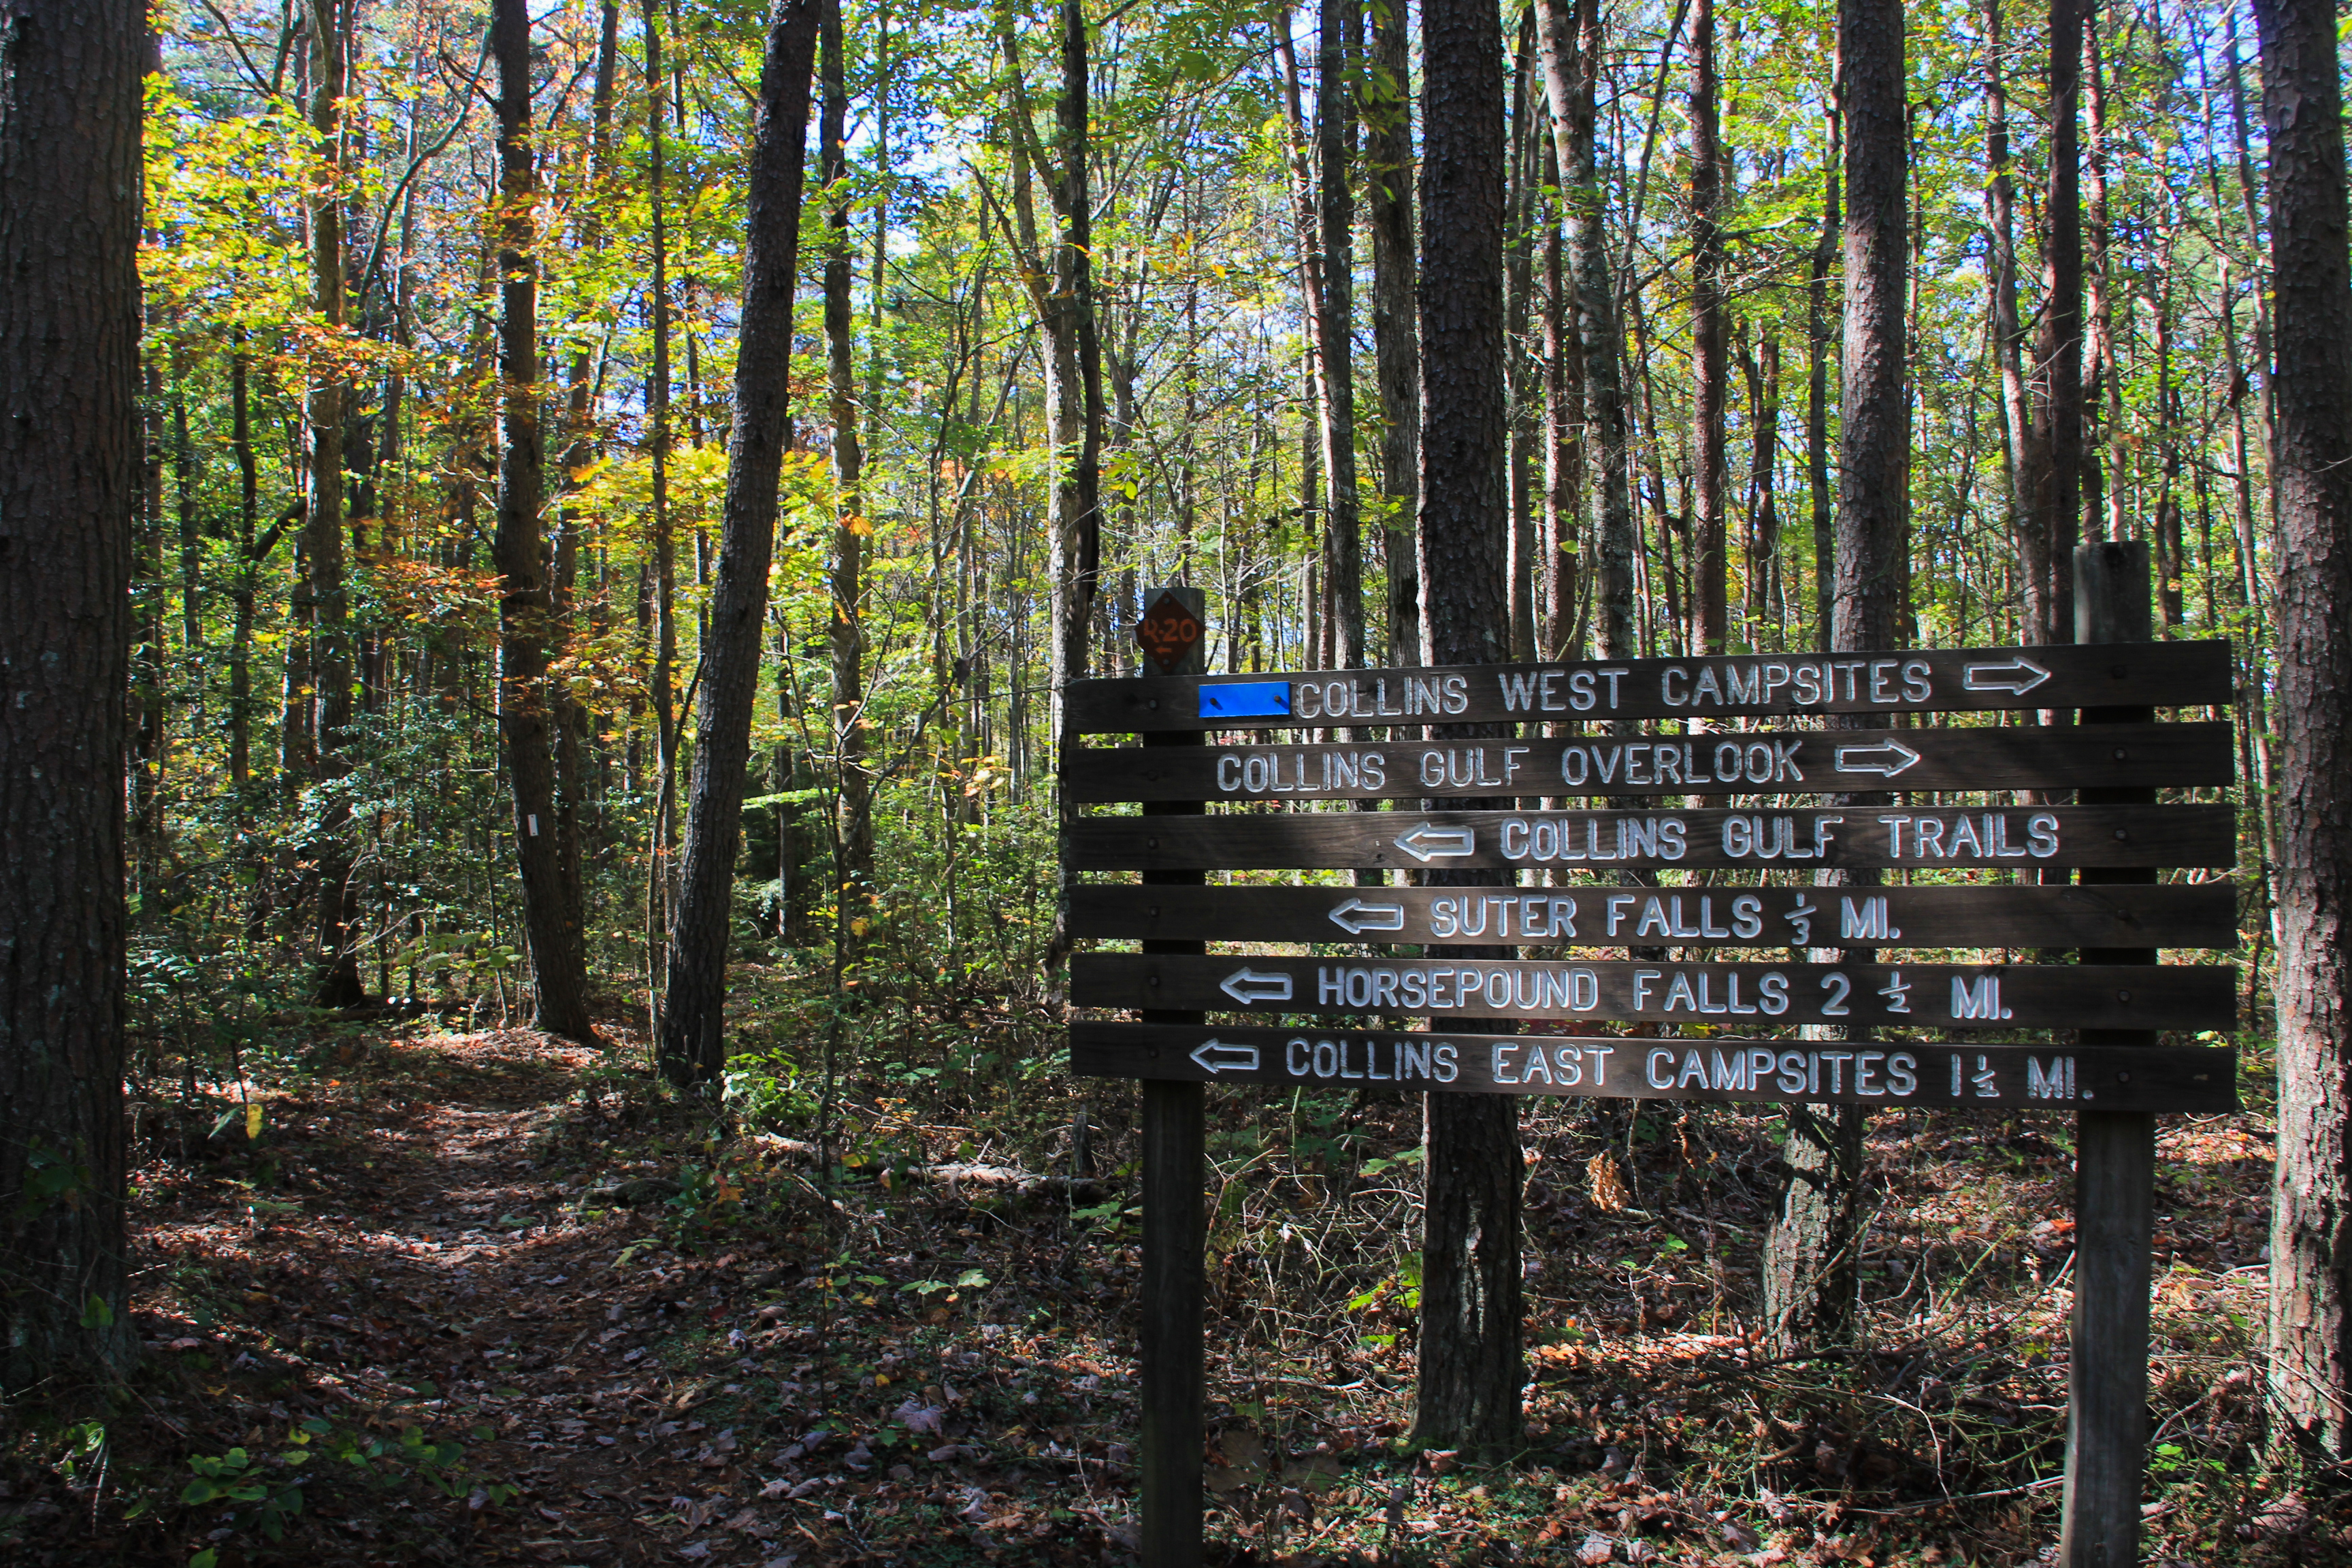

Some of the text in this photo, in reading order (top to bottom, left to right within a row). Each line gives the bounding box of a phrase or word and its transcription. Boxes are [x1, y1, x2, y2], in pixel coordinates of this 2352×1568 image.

[1294, 659, 1931, 719] COLLINS WEST CAMPSITES
[1218, 739, 1803, 793] COLLINS GULF OVERLOOK
[1500, 812, 2059, 862] COLLINS GULF TRAILS
[1429, 894, 1578, 938] SUTER
[1607, 894, 1763, 940] FALLS
[1840, 896, 1901, 940] MI.
[1318, 966, 1599, 1011] HORSEPOUND
[1633, 970, 1790, 1015] FALLS
[1820, 973, 1851, 1015] 2
[1951, 975, 2012, 1020] MI.
[1286, 1038, 1459, 1082] COLLINS
[1492, 1043, 1614, 1086] EAST
[1646, 1050, 1917, 1096] CAMPSITES
[2027, 1056, 2094, 1100] MI.
